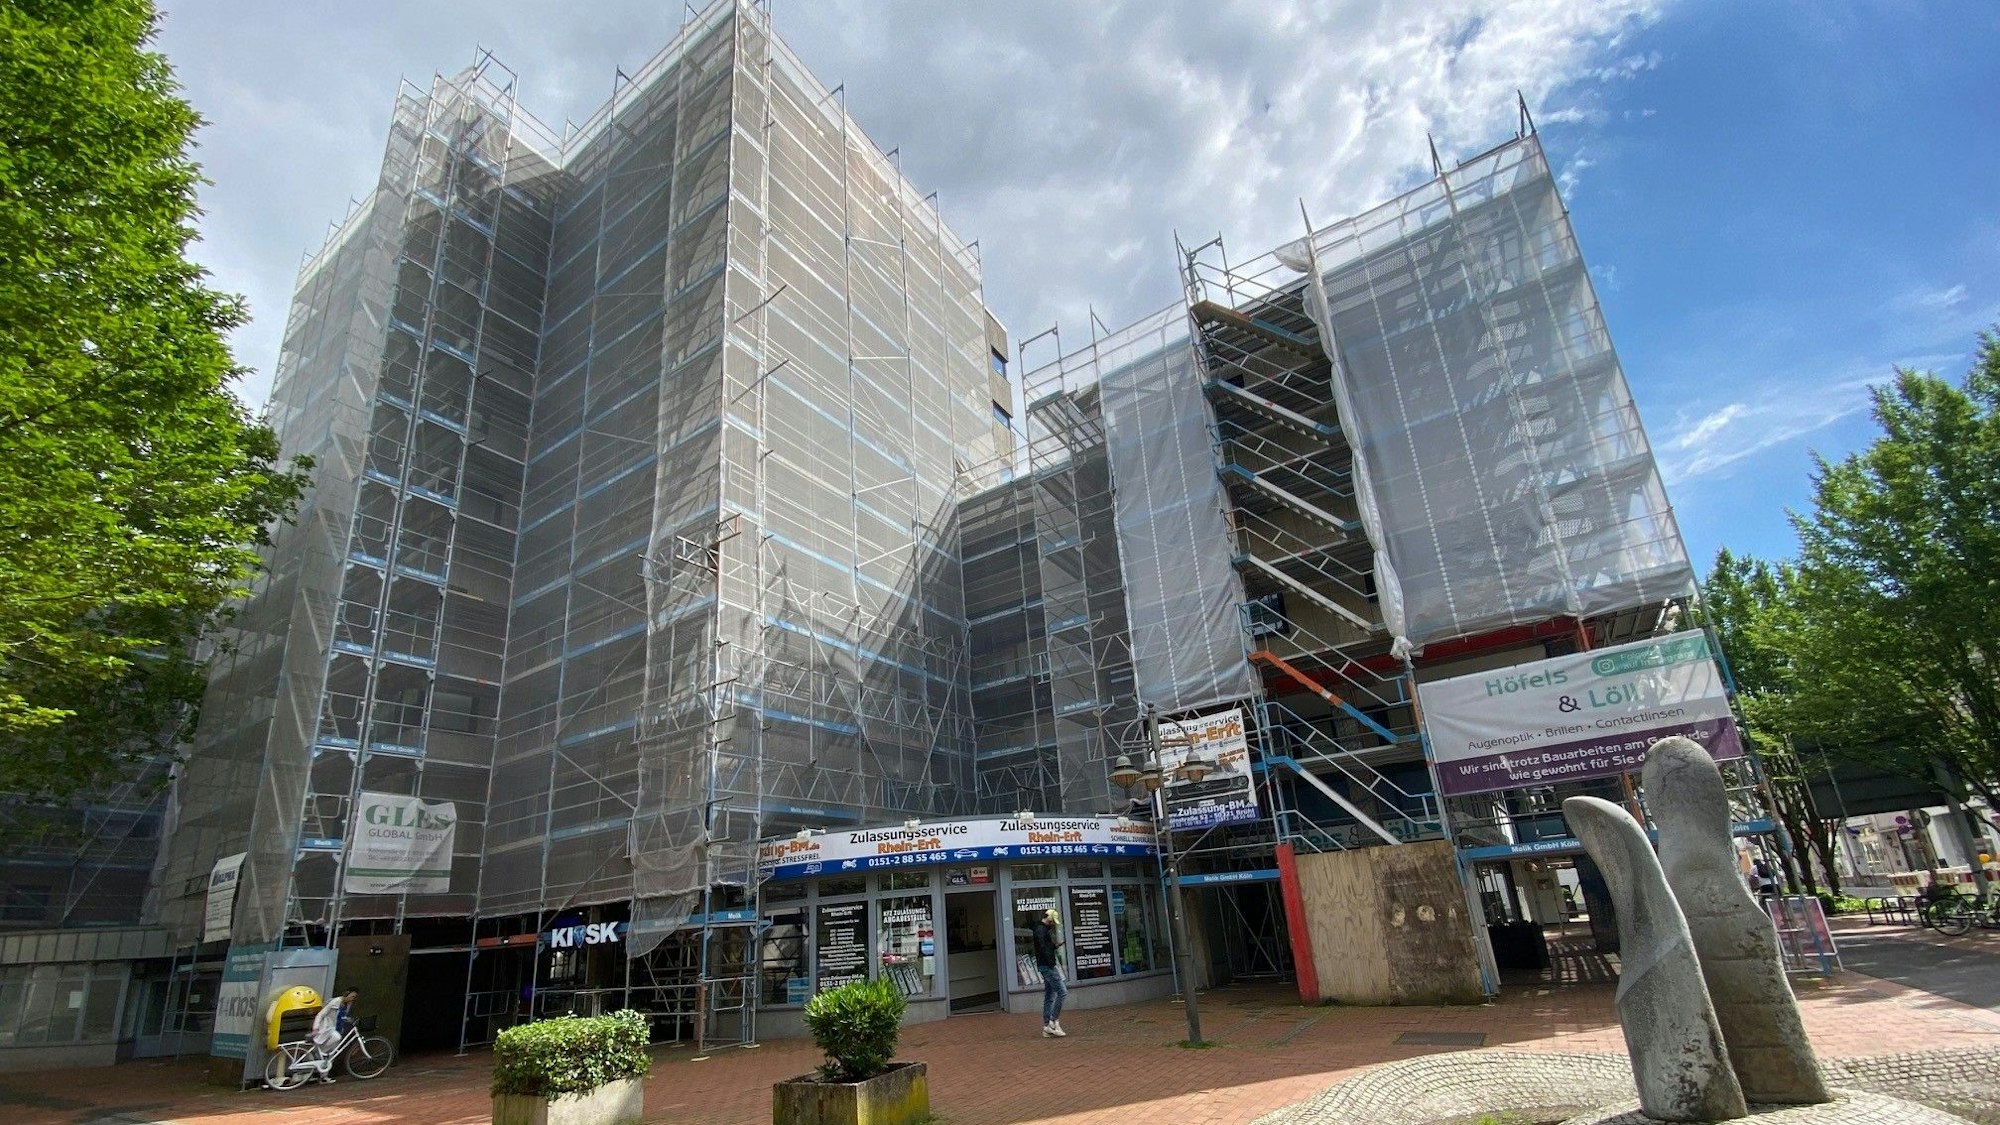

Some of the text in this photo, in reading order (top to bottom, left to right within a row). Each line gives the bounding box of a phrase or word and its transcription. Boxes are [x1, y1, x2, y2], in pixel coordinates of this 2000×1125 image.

[1485, 669, 1569, 697] Höfels
[1558, 695, 1582, 713] &
[1468, 707, 1685, 751] Augenoptik Brillen Contactlinsen
[1459, 764, 1480, 776] Wir
[1509, 756, 1541, 768] trotz
[1541, 744, 1622, 763] Bauarbeiten
[1624, 741, 1646, 751] am
[1509, 770, 1531, 781] wie
[1532, 761, 1588, 780] gewohnt
[1590, 758, 1610, 769] für
[1612, 754, 1635, 766] Sie
[368, 828, 413, 839] GLOBAL
[850, 823, 968, 844] Zulassungsservice
[1000, 819, 1100, 832] Zulassungsservice
[1028, 831, 1083, 843] Rhein-Erft
[878, 838, 942, 854] Rhein-Erft
[1020, 846, 1050, 855] 0151-2
[1051, 846, 1062, 854] 88
[1074, 845, 1088, 853] 465
[1533, 842, 1559, 851] GmbH
[1560, 840, 1581, 848] Köln
[868, 852, 947, 868] 0151-2 88 55 465
